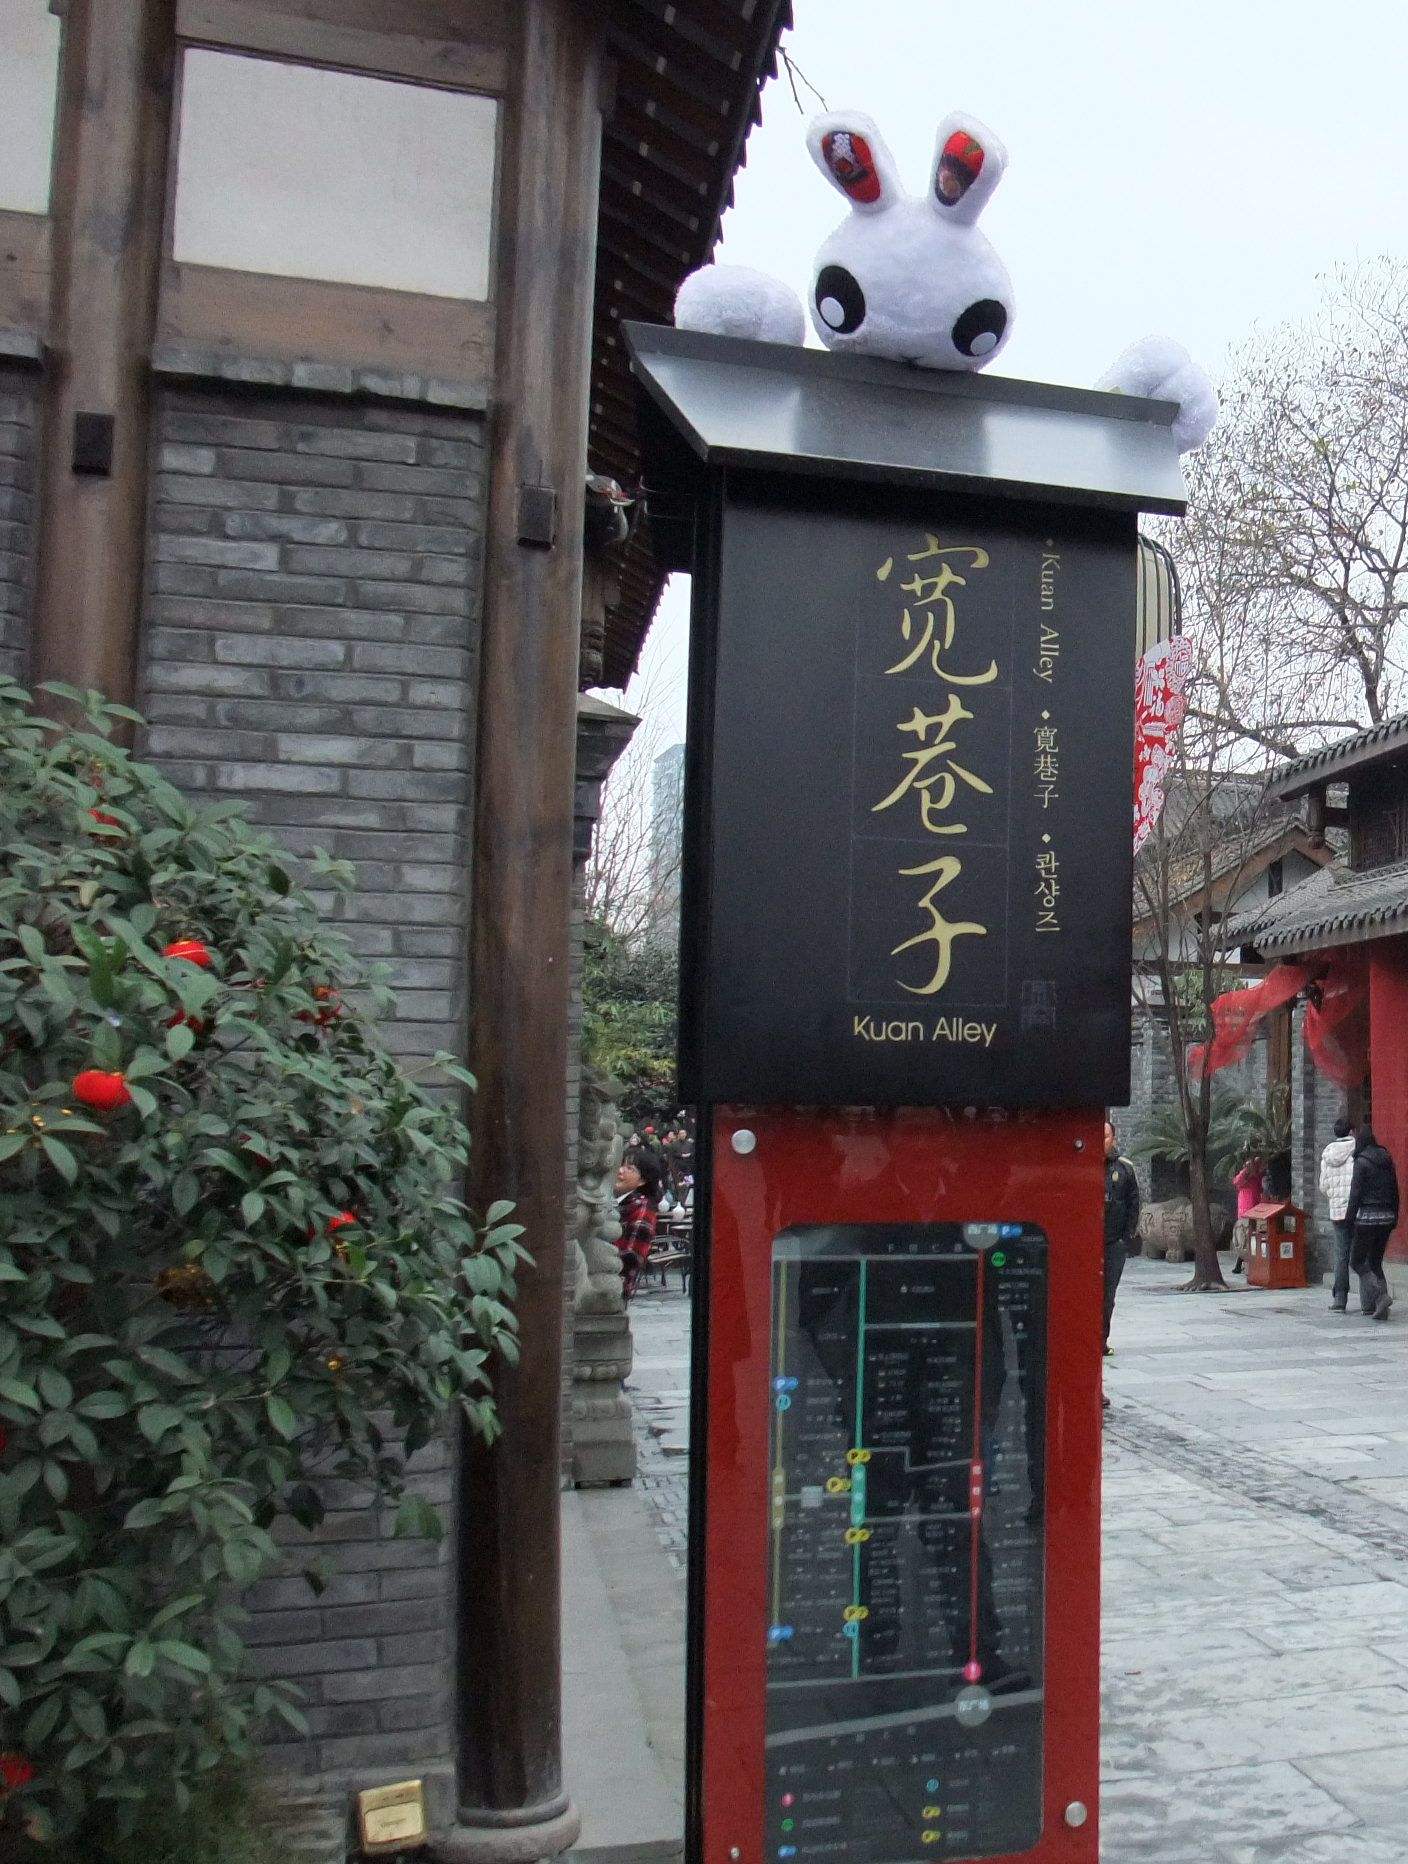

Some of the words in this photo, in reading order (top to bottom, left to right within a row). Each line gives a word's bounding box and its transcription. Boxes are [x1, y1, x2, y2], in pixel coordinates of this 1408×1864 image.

[1040, 552, 1061, 611] Kuan
[1032, 623, 1060, 684] Alley
[870, 532, 999, 995] 宽巷子
[1034, 850, 1061, 932] 콴샹즈
[853, 1015, 924, 1042] Kuan
[932, 1016, 997, 1048] Alley
